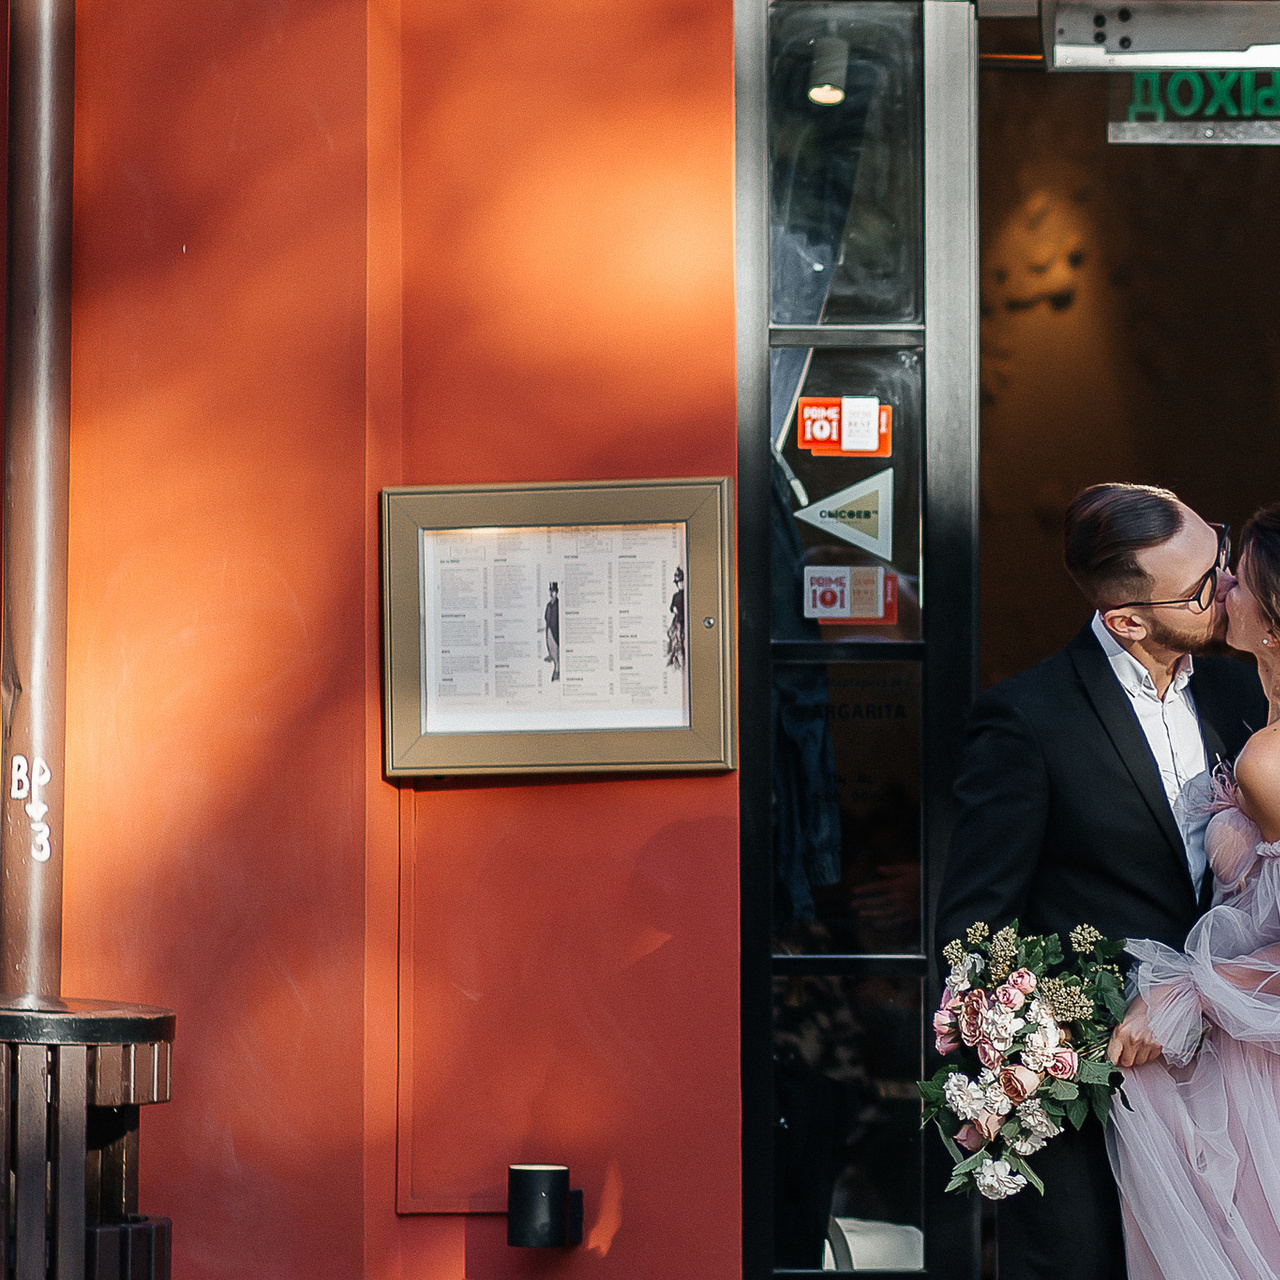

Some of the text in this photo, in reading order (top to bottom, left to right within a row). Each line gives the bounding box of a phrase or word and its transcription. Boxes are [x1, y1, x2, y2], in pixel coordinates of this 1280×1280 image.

[803, 406, 839, 419] PRIME
[804, 419, 838, 441] 101
[810, 576, 846, 587] PRIME
[811, 588, 846, 608] 101
